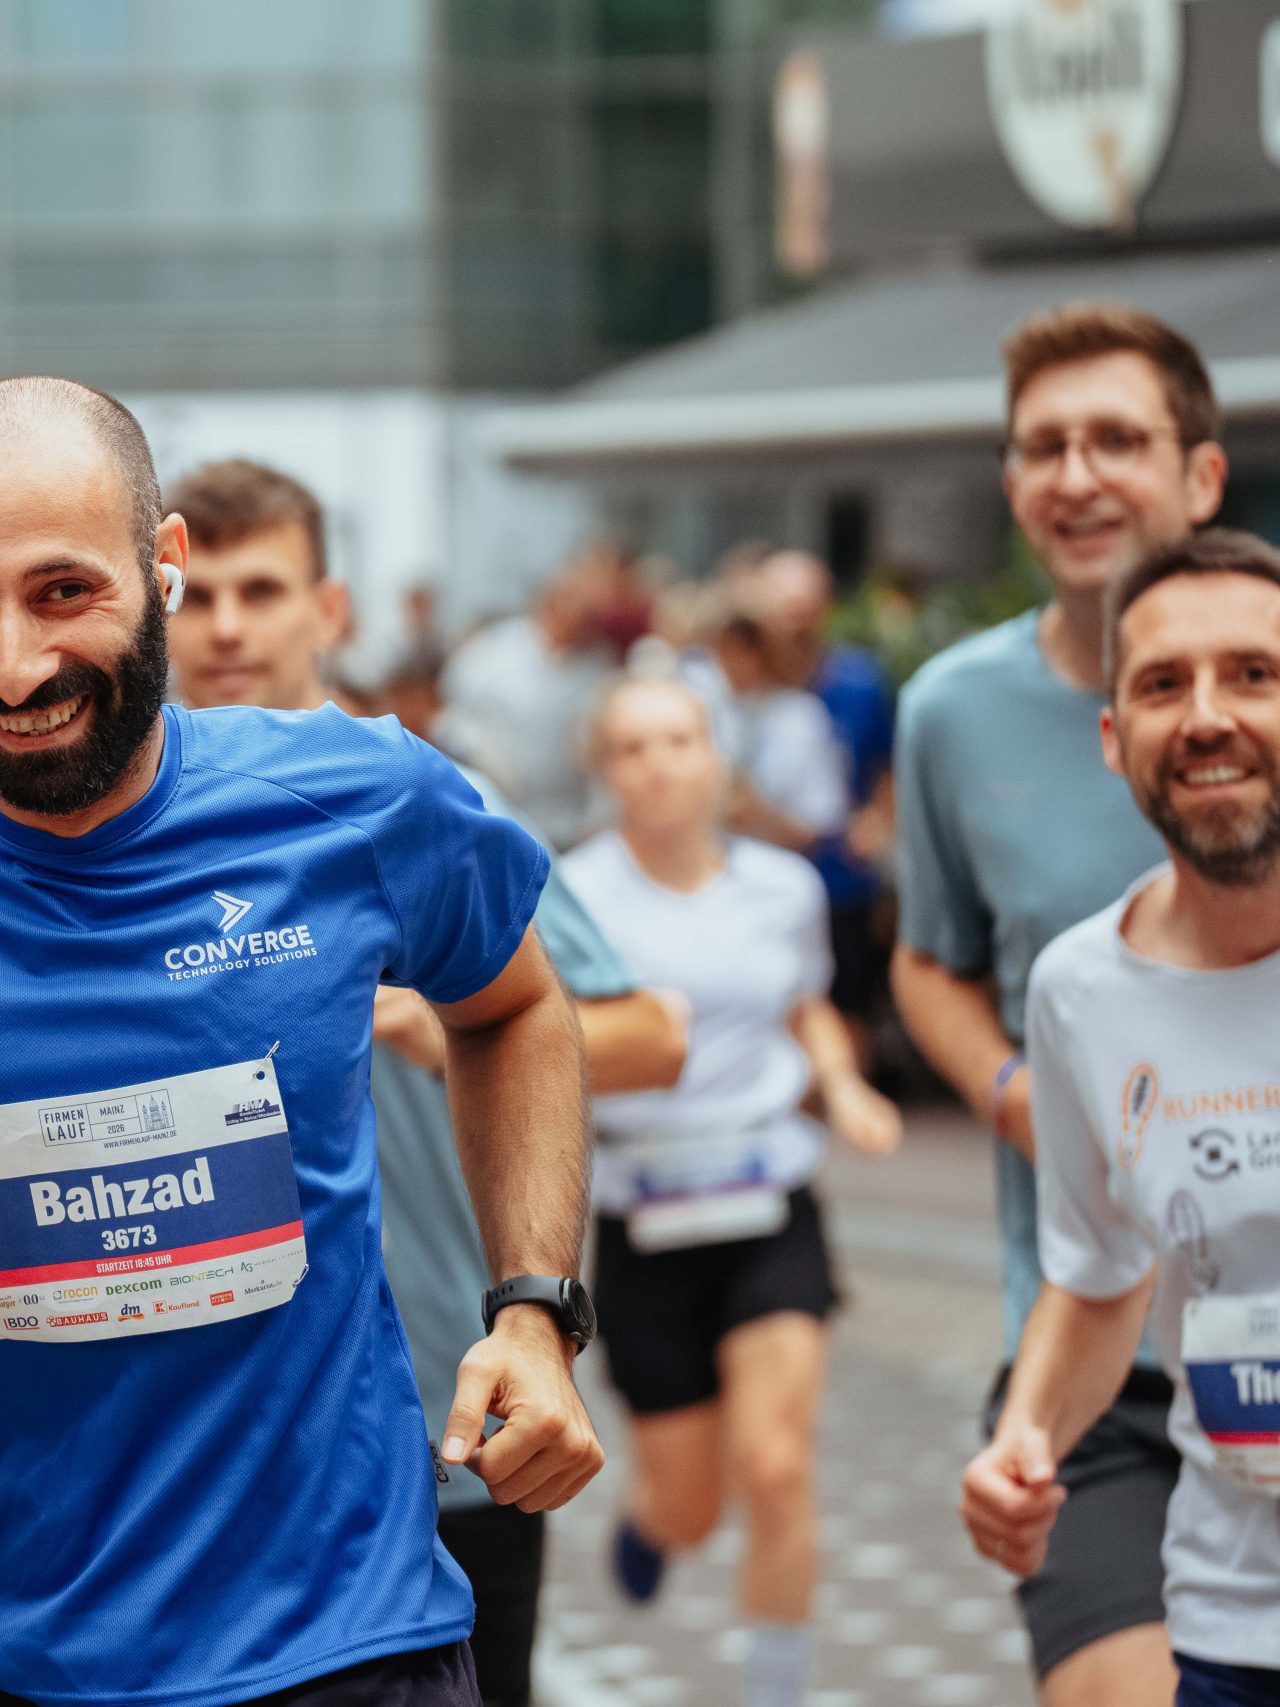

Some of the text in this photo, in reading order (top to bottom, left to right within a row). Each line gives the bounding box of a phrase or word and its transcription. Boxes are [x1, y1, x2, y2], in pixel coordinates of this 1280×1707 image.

[164, 924, 314, 970] CONVERGE
[167, 947, 318, 982] TECHNOLOGY SOLUTIONS
[44, 1109, 84, 1124] FIRMEN
[99, 1104, 125, 1117] MAINZ
[46, 1122, 86, 1142] LAUF
[107, 1124, 125, 1135] 2026
[103, 1130, 177, 1149] WWW.FIRMENLAUF-MAINZ.DE
[29, 1156, 215, 1227] Bahzad
[101, 1224, 157, 1251] 3673
[96, 1254, 173, 1274] STARTZEIT 18:45 UHR
[63, 1286, 98, 1299] rocon
[120, 1303, 141, 1316] dm
[168, 1301, 200, 1312] Kaufland
[8, 1316, 39, 1328] BDO
[55, 1312, 108, 1326] BAUHAUS
